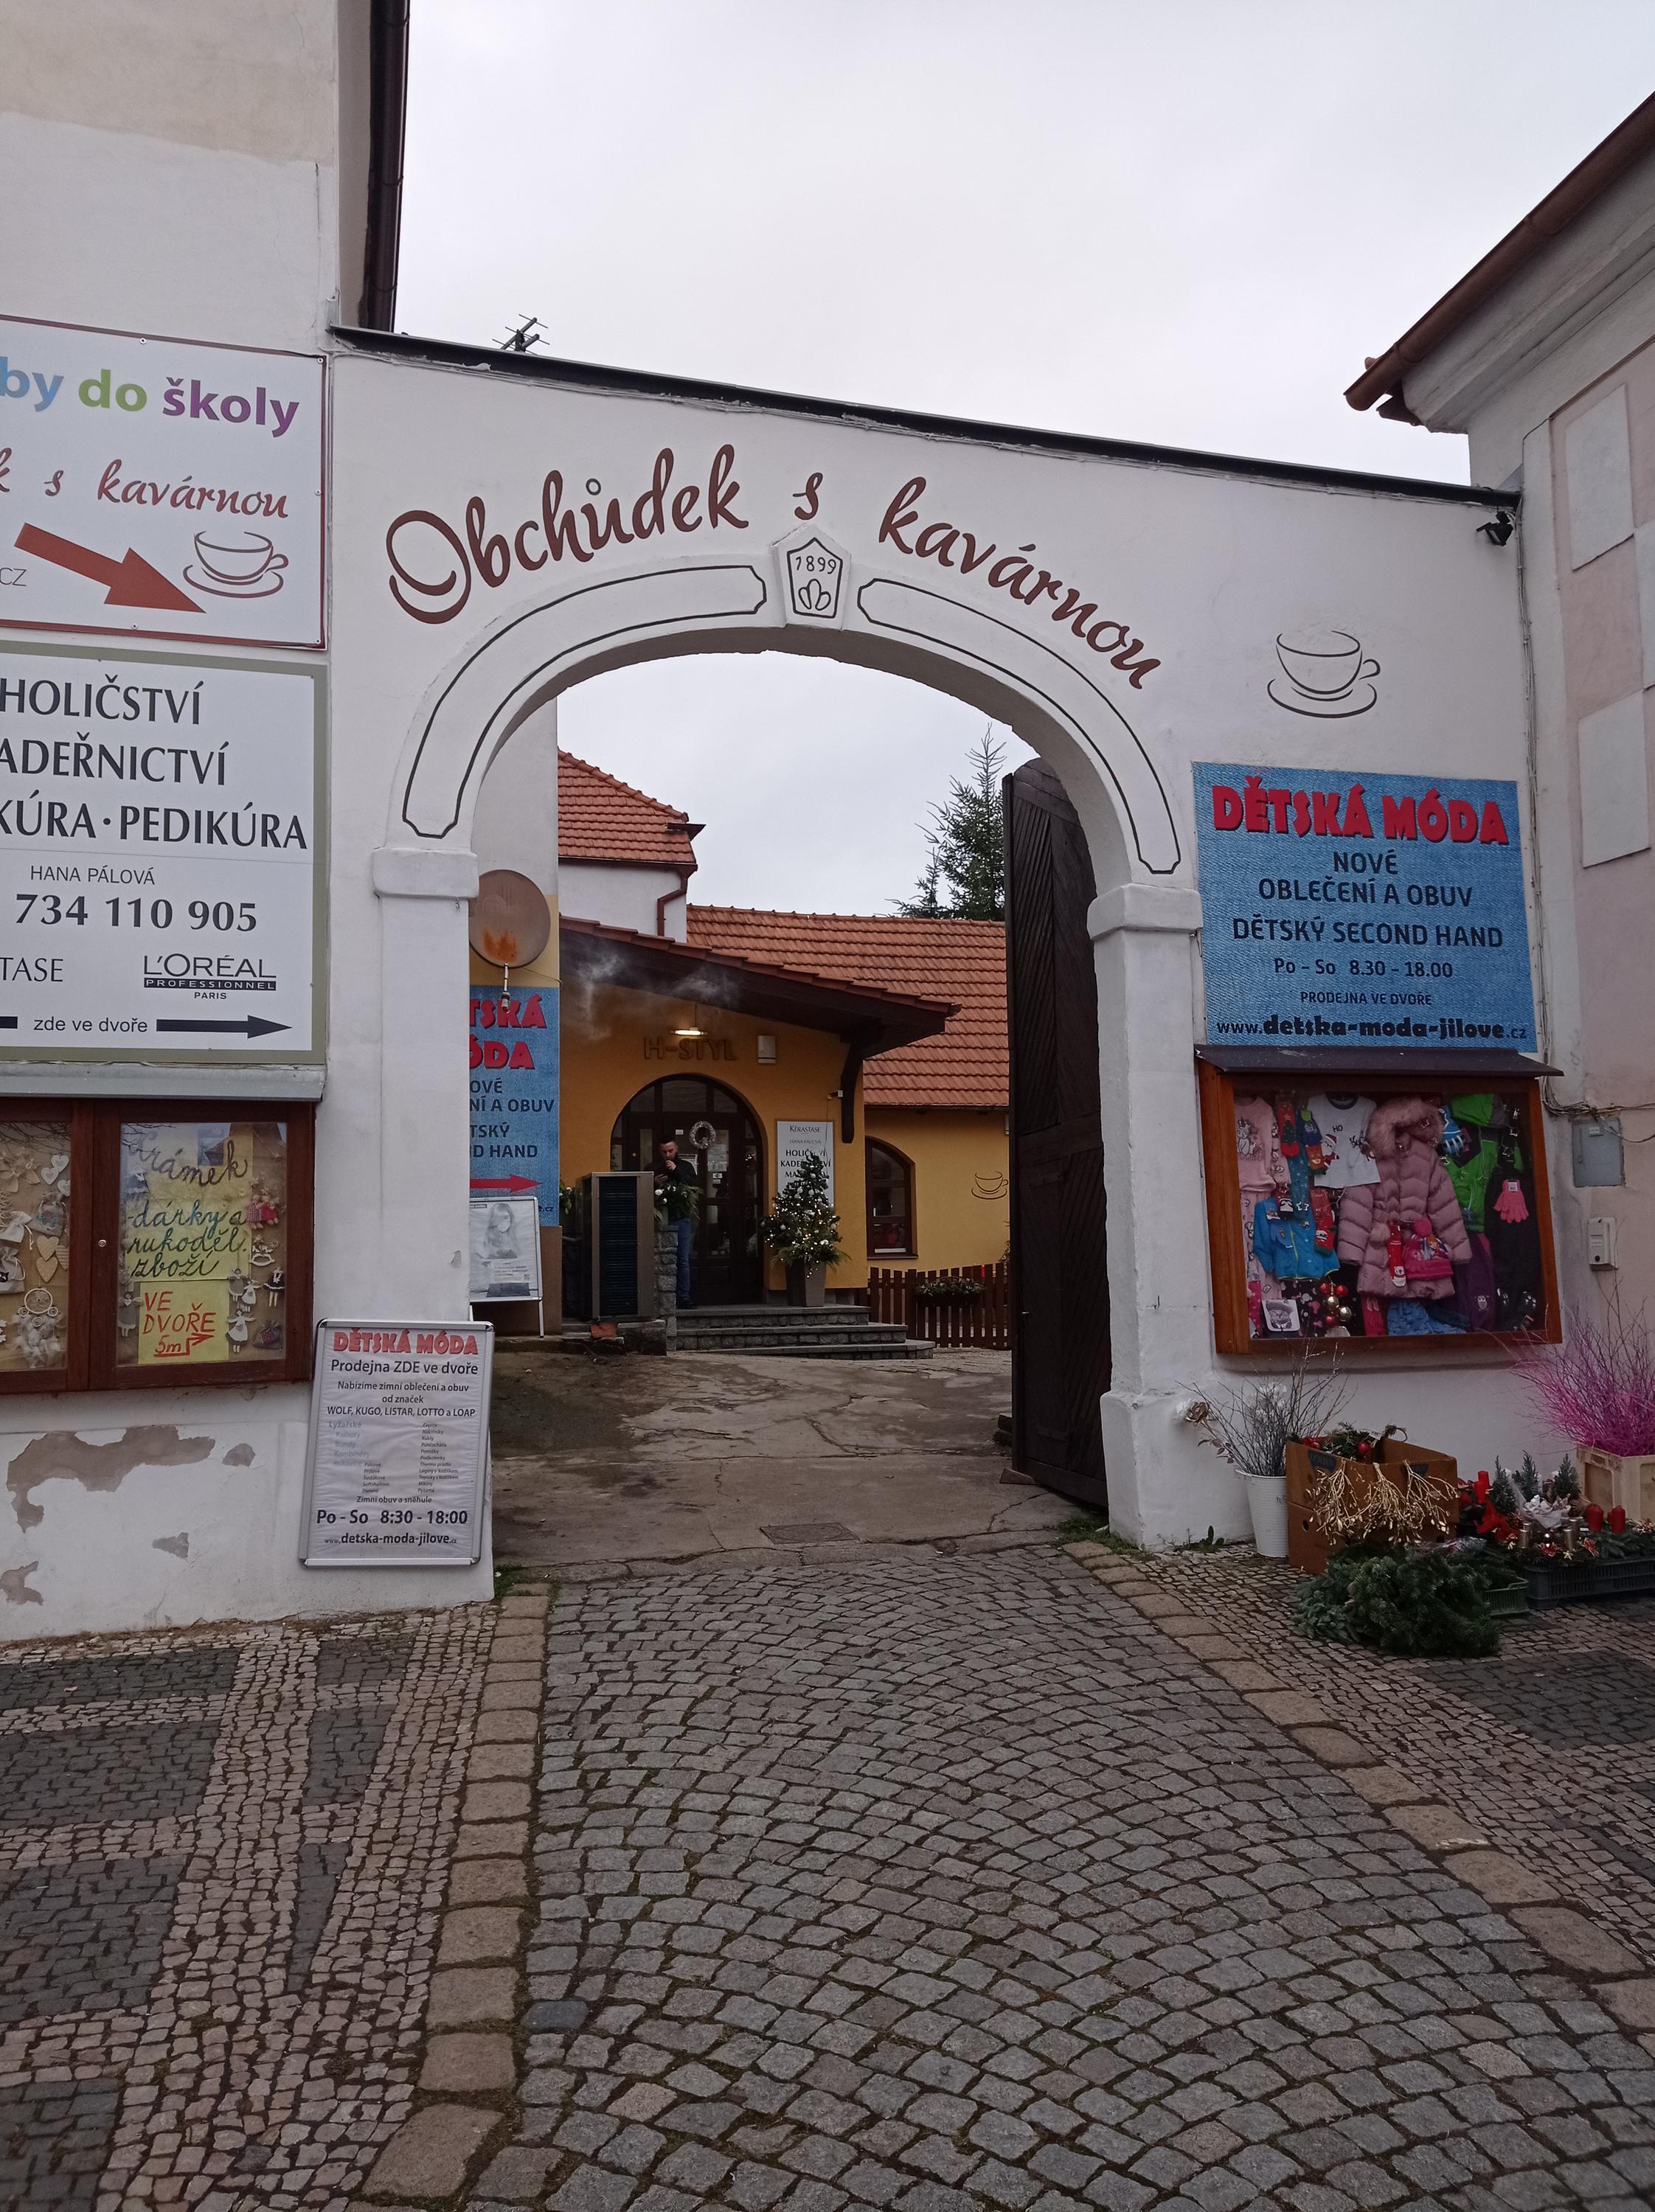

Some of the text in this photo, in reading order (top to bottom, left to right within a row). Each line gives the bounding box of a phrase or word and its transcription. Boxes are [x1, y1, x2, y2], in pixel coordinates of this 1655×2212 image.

[78, 369, 148, 411] do
[162, 377, 299, 438] školy
[44, 470, 64, 497] s
[97, 459, 289, 518] kavárnou
[386, 444, 1161, 689] Obchůdek s kavárnou
[795, 555, 837, 575] 1899
[0, 674, 204, 726] HOLIČSTVÍ
[1212, 775, 1510, 846] DĚTSKÁ MÓDA
[1333, 849, 1398, 875] NOVÉ
[30, 865, 156, 886] HANA PÁLOVÁ
[1258, 876, 1473, 908] OBLEČENÍ A OBUV
[15, 893, 257, 932] 734 110 905
[1232, 914, 1504, 948] DĚTSKÝ SECOND HAND
[1274, 958, 1297, 975] Po
[1315, 959, 1337, 975] So
[1349, 960, 1387, 977] 8.30
[1404, 961, 1454, 978] 18.00
[145, 979, 276, 991] PROFESSIONNEL
[193, 991, 227, 1000] PARIS
[1300, 990, 1432, 1006] PRODEJNA VE DVOŘE
[34, 1016, 149, 1034] zde ve dvoře
[1216, 1014, 1527, 1041] www.detska-moda-jilove.cz
[644, 1036, 738, 1061] H-STYL
[490, 1099, 503, 1112] A
[507, 1099, 555, 1112] OBUV
[490, 1144, 538, 1158] HAND
[131, 1250, 220, 1278] zboží
[144, 1290, 173, 1312] VE
[142, 1302, 217, 1335] DVOŘE
[155, 1335, 181, 1354] 5m
[333, 1327, 479, 1354] DĚTSKÁ MÓDA
[331, 1359, 479, 1376] Prodejna ZDE ve dvoře
[338, 1381, 378, 1390] Nabízíme
[379, 1382, 403, 1390] zimní
[403, 1382, 440, 1391] oblečení
[448, 1383, 469, 1391] obuv
[382, 1394, 424, 1403] od značek
[327, 1406, 354, 1416] WOLF,
[355, 1407, 383, 1416] KUGO,
[384, 1407, 415, 1416] LISTAR,
[417, 1408, 445, 1416] LOTTO
[453, 1408, 476, 1417] LOAP
[356, 1495, 378, 1503] Zimní
[316, 1509, 336, 1524] Po
[349, 1509, 369, 1524] So
[380, 1510, 413, 1524] 8:30
[427, 1510, 468, 1525] 18:00
